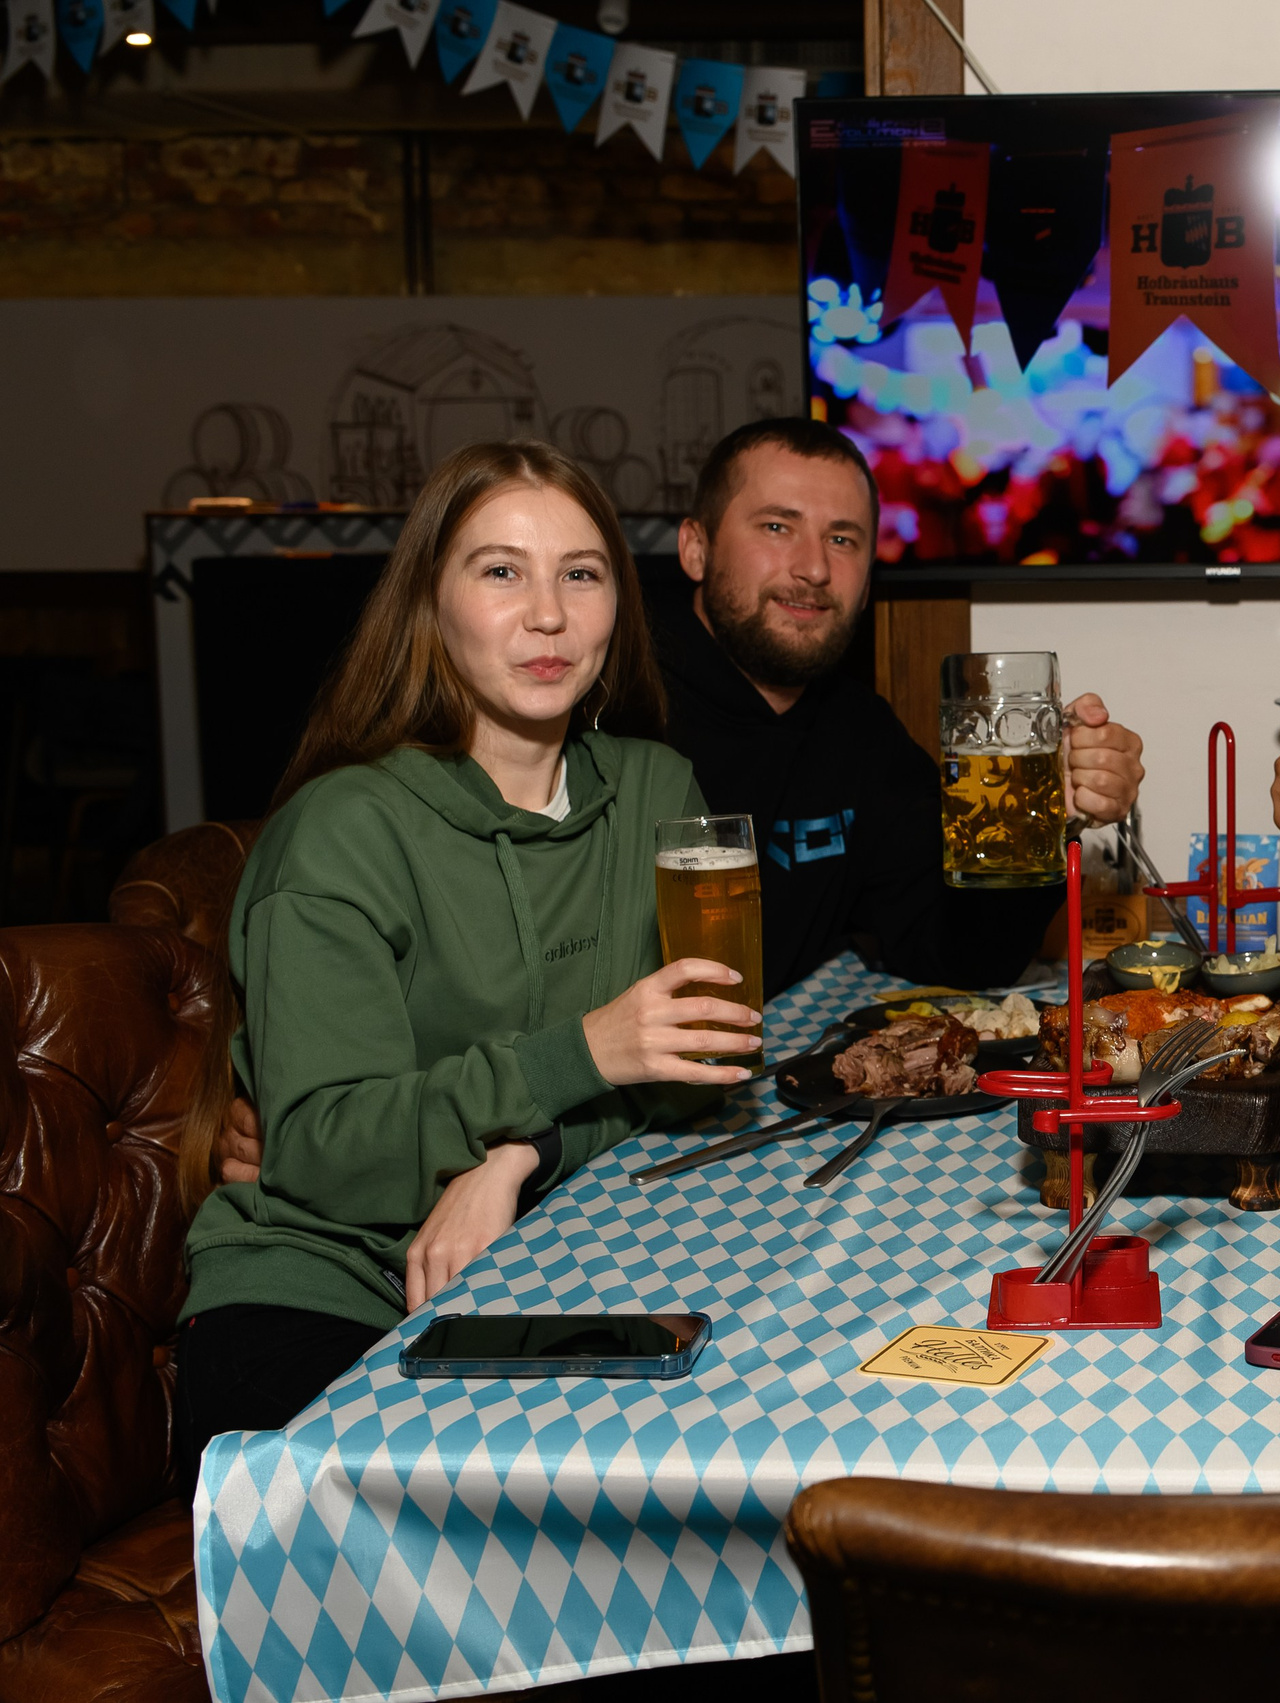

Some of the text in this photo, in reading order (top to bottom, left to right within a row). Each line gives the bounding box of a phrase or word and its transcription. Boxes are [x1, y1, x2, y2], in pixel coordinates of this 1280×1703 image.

[1131, 216, 1245, 253] H B
[1144, 291, 1231, 306] Traunstein
[910, 1339, 993, 1370] Helles
